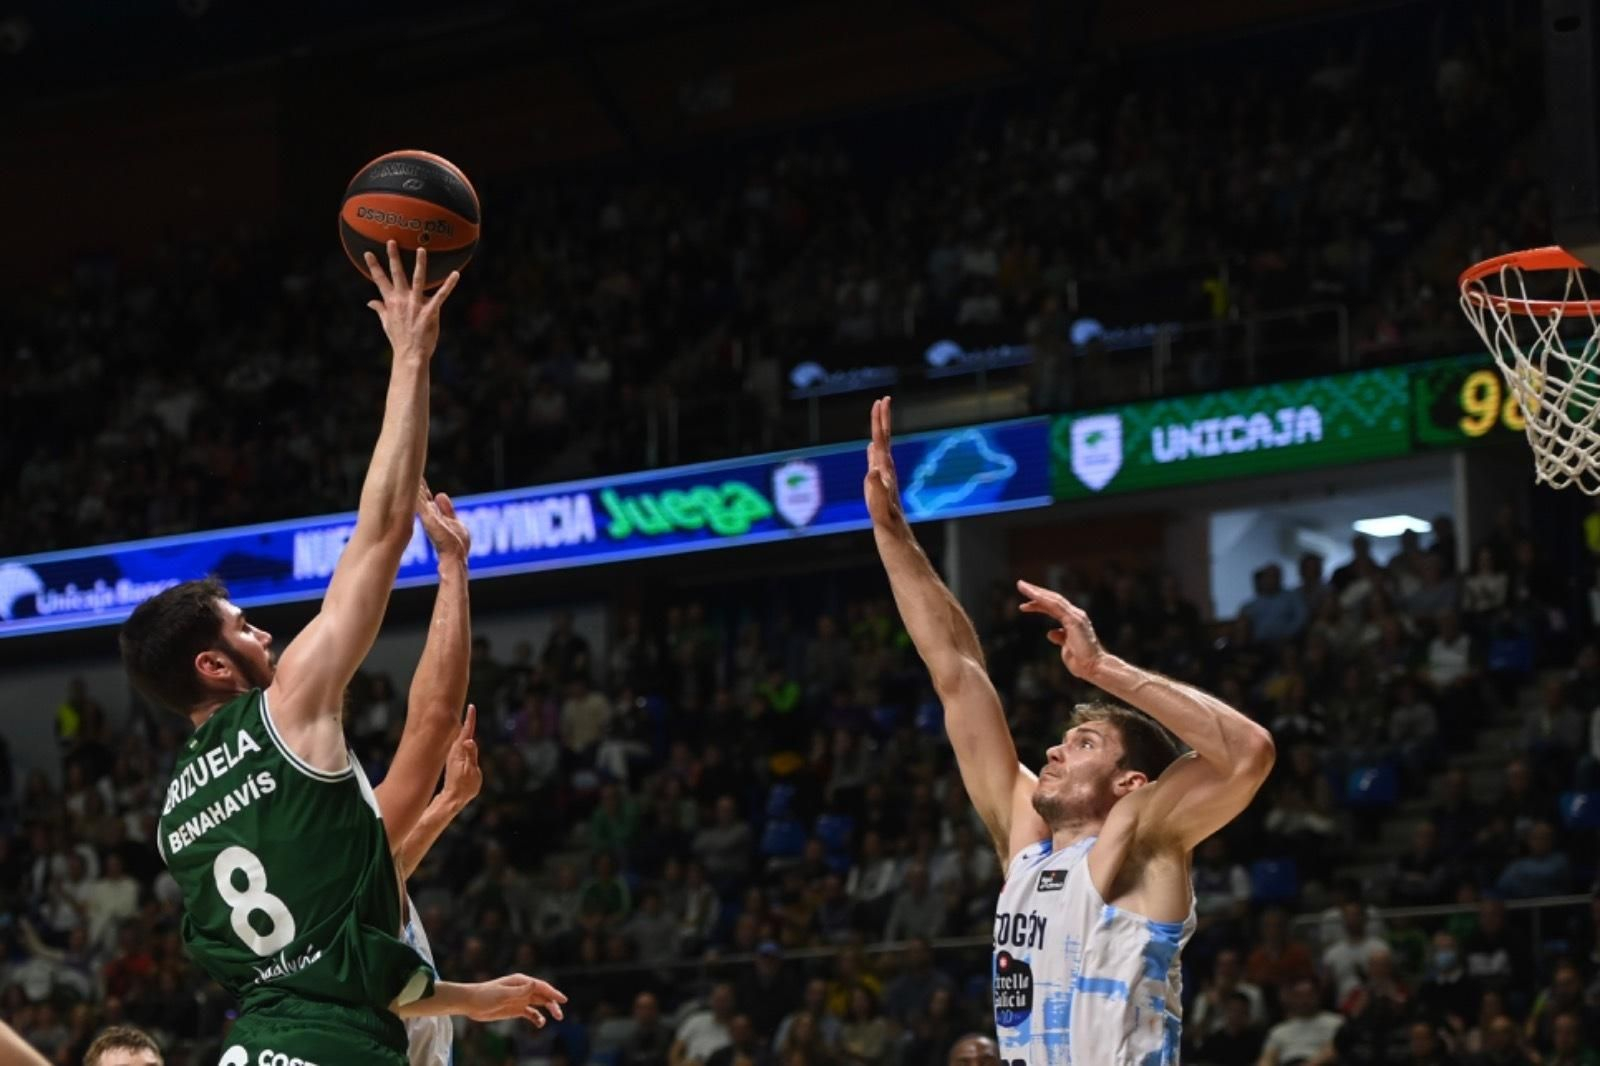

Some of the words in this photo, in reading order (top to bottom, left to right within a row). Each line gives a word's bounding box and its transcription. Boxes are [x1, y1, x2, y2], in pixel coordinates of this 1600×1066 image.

[1151, 404, 1322, 463] UNICAJA
[601, 484, 772, 538] Juega
[168, 771, 276, 854] BENAHAVÍS
[213, 846, 296, 957] 8
